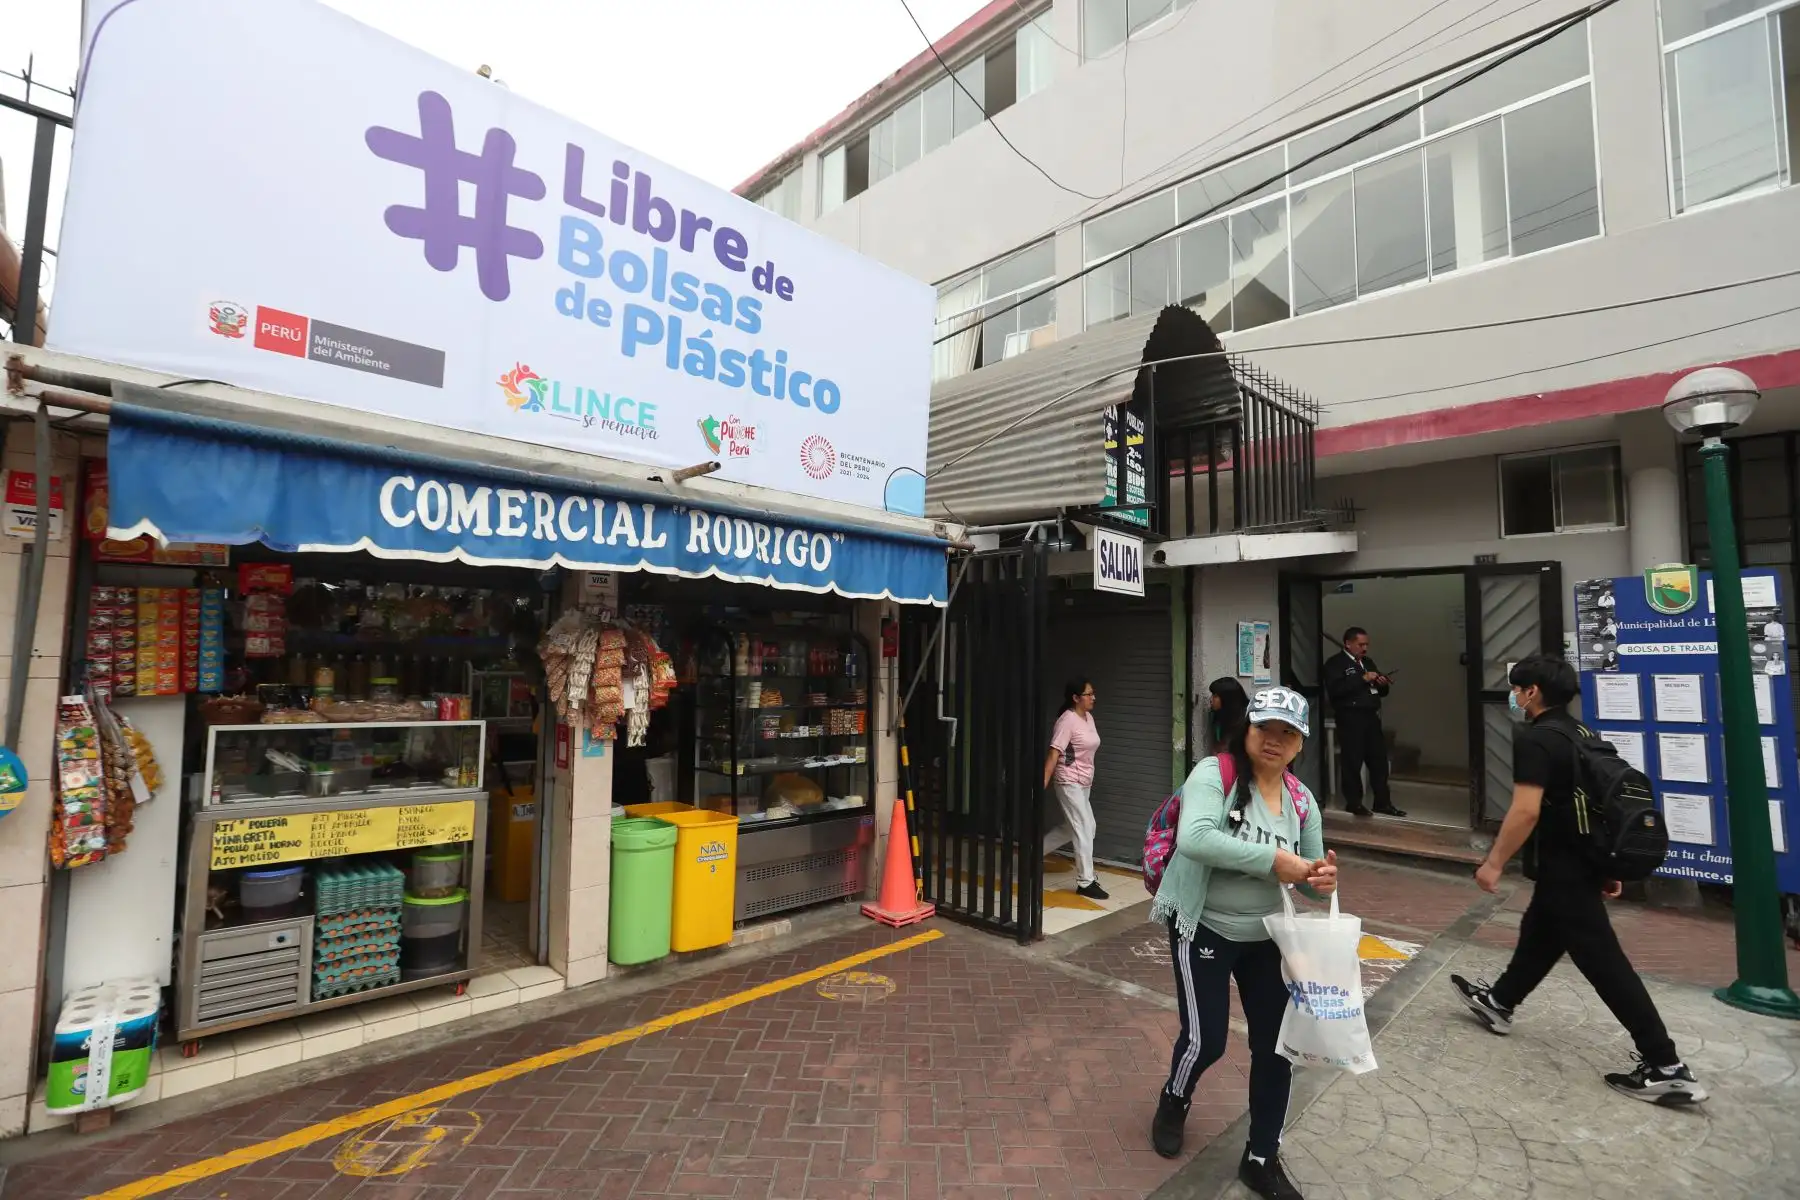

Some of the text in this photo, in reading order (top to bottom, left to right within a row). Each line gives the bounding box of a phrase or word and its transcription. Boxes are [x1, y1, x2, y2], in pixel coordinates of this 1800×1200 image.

[563, 142, 795, 301] Libre de
[557, 214, 763, 334] Bolsas
[261, 322, 302, 342] PERÚ
[314, 335, 374, 357] Ministerio
[554, 281, 841, 415] de Plástico
[313, 345, 391, 371] del Ambiente
[552, 381, 659, 429] LINCE
[582, 414, 660, 440] se renueva
[729, 414, 741, 424] Con
[730, 440, 750, 457] Perú
[840, 452, 886, 469] BICENTENARIO
[840, 460, 852, 469] DEL
[840, 469, 870, 480] 2021 2024
[379, 475, 667, 549] COMERCIAL
[1100, 538, 1140, 584] SALIDA
[592, 576, 609, 584] VISA
[1615, 619, 1685, 631] Municipalidad
[1627, 645, 1659, 653] BOLSA
[1680, 644, 1717, 652] TRABAJ
[1254, 689, 1307, 716] SEXY
[270, 839, 302, 850] HORNO
[214, 856, 236, 867] AJO
[1682, 849, 1695, 860] tu
[1699, 850, 1733, 865] cham
[710, 865, 716, 873] 3
[1300, 981, 1339, 995] Libre
